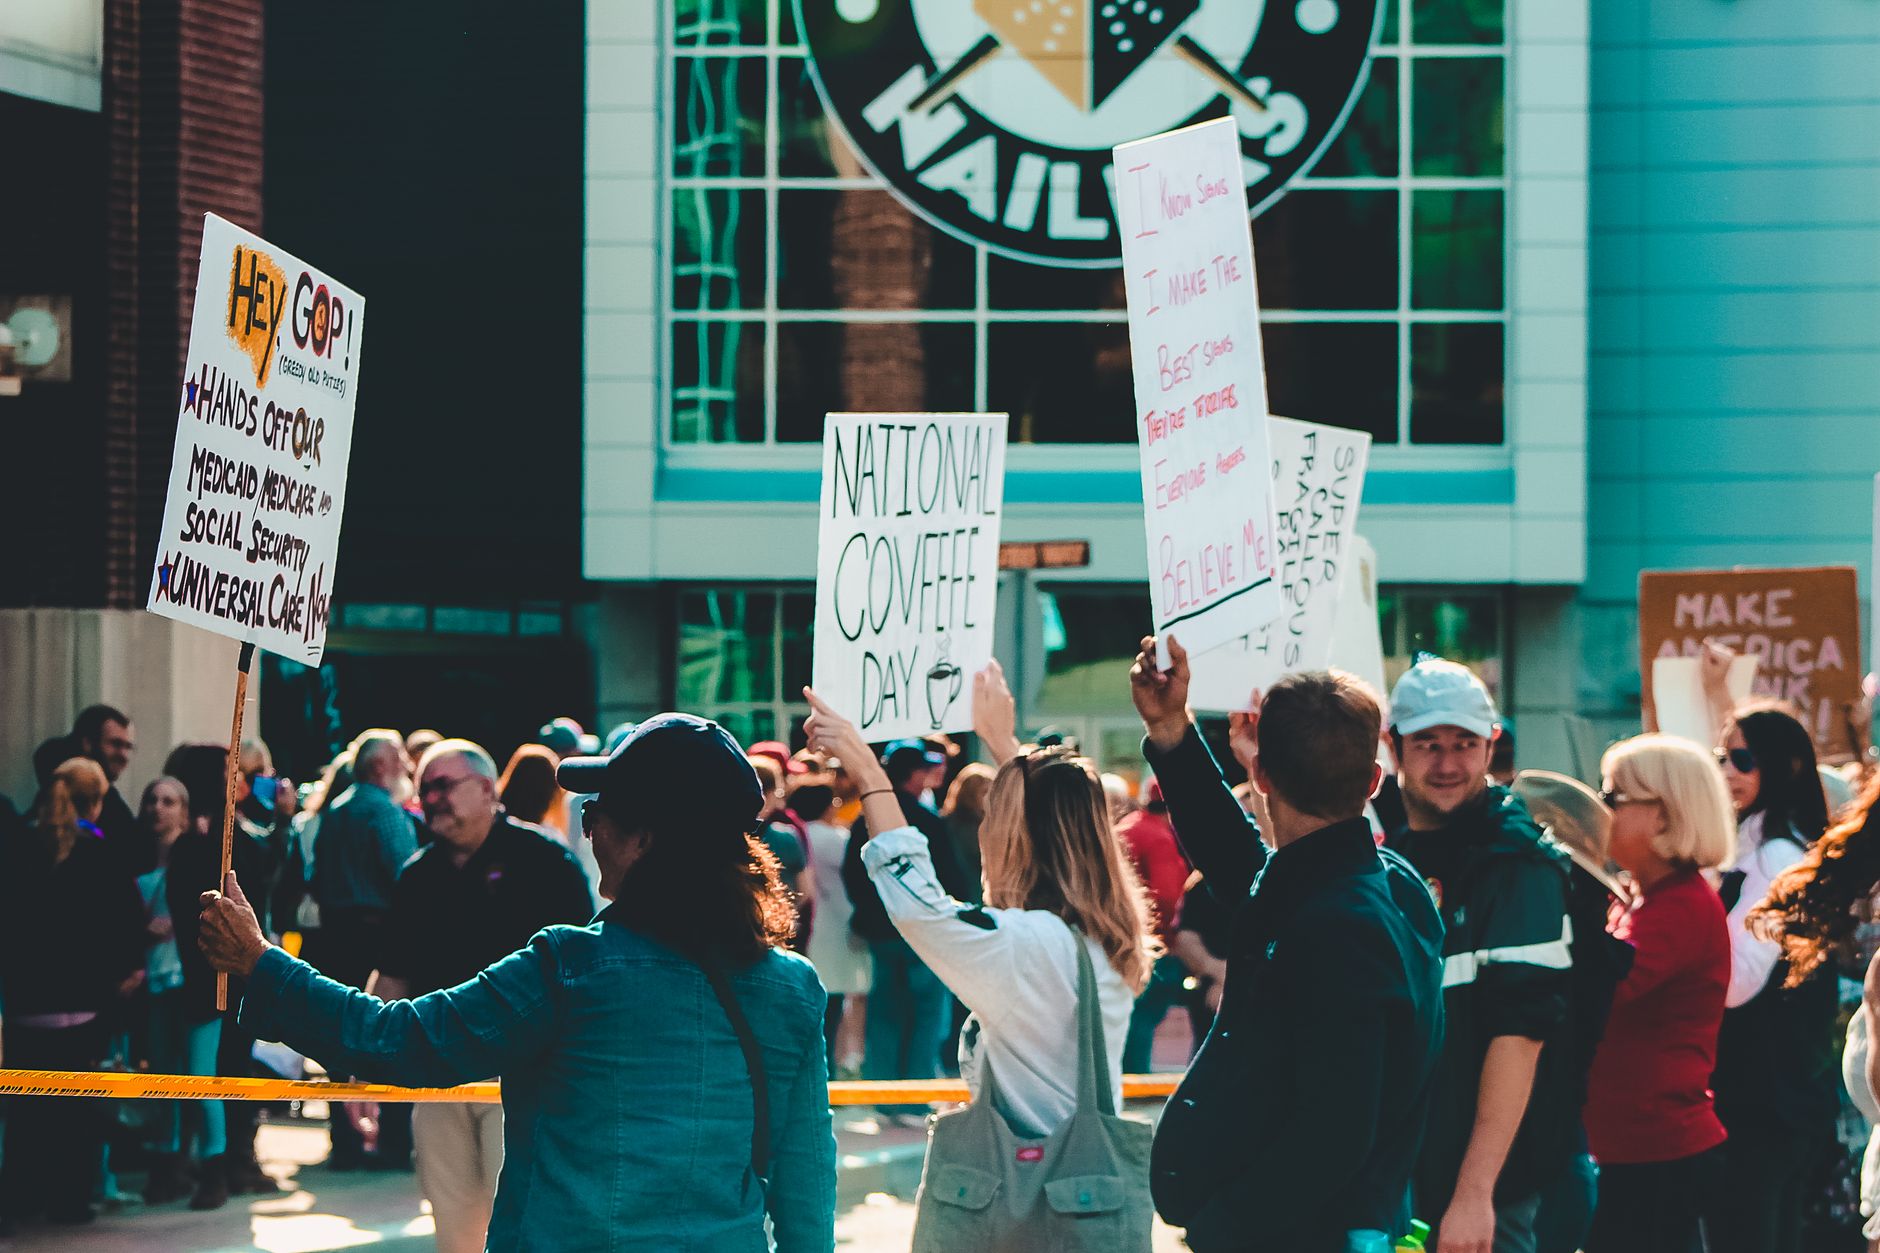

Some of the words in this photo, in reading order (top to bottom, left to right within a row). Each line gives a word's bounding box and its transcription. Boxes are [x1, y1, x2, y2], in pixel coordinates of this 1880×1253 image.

[861, 64, 1307, 241] NAILS
[1128, 163, 1159, 239] I
[1159, 171, 1191, 219] KNOW
[292, 271, 353, 371] GOP!
[1143, 269, 1160, 317] I
[1168, 269, 1207, 306] MAKE
[1211, 255, 1242, 291] THE
[308, 366, 319, 385] OLD
[1157, 343, 1199, 391] BEST
[196, 363, 258, 437] HANDS
[263, 400, 293, 451] OFF
[292, 407, 325, 467] OUR
[833, 423, 995, 518] NATIONAL
[180, 501, 242, 551] SOCIAL
[246, 519, 310, 597] SECURITY
[1317, 446, 1354, 585] SUPER
[170, 551, 265, 628] UNIVERSAL
[268, 573, 304, 634] CARE
[834, 527, 979, 641] COVFEFE
[1160, 535, 1236, 617] BELIEVE
[1284, 488, 1328, 668] CALLOUS
[1674, 588, 1793, 629] MAKE
[861, 645, 917, 729] DAY
